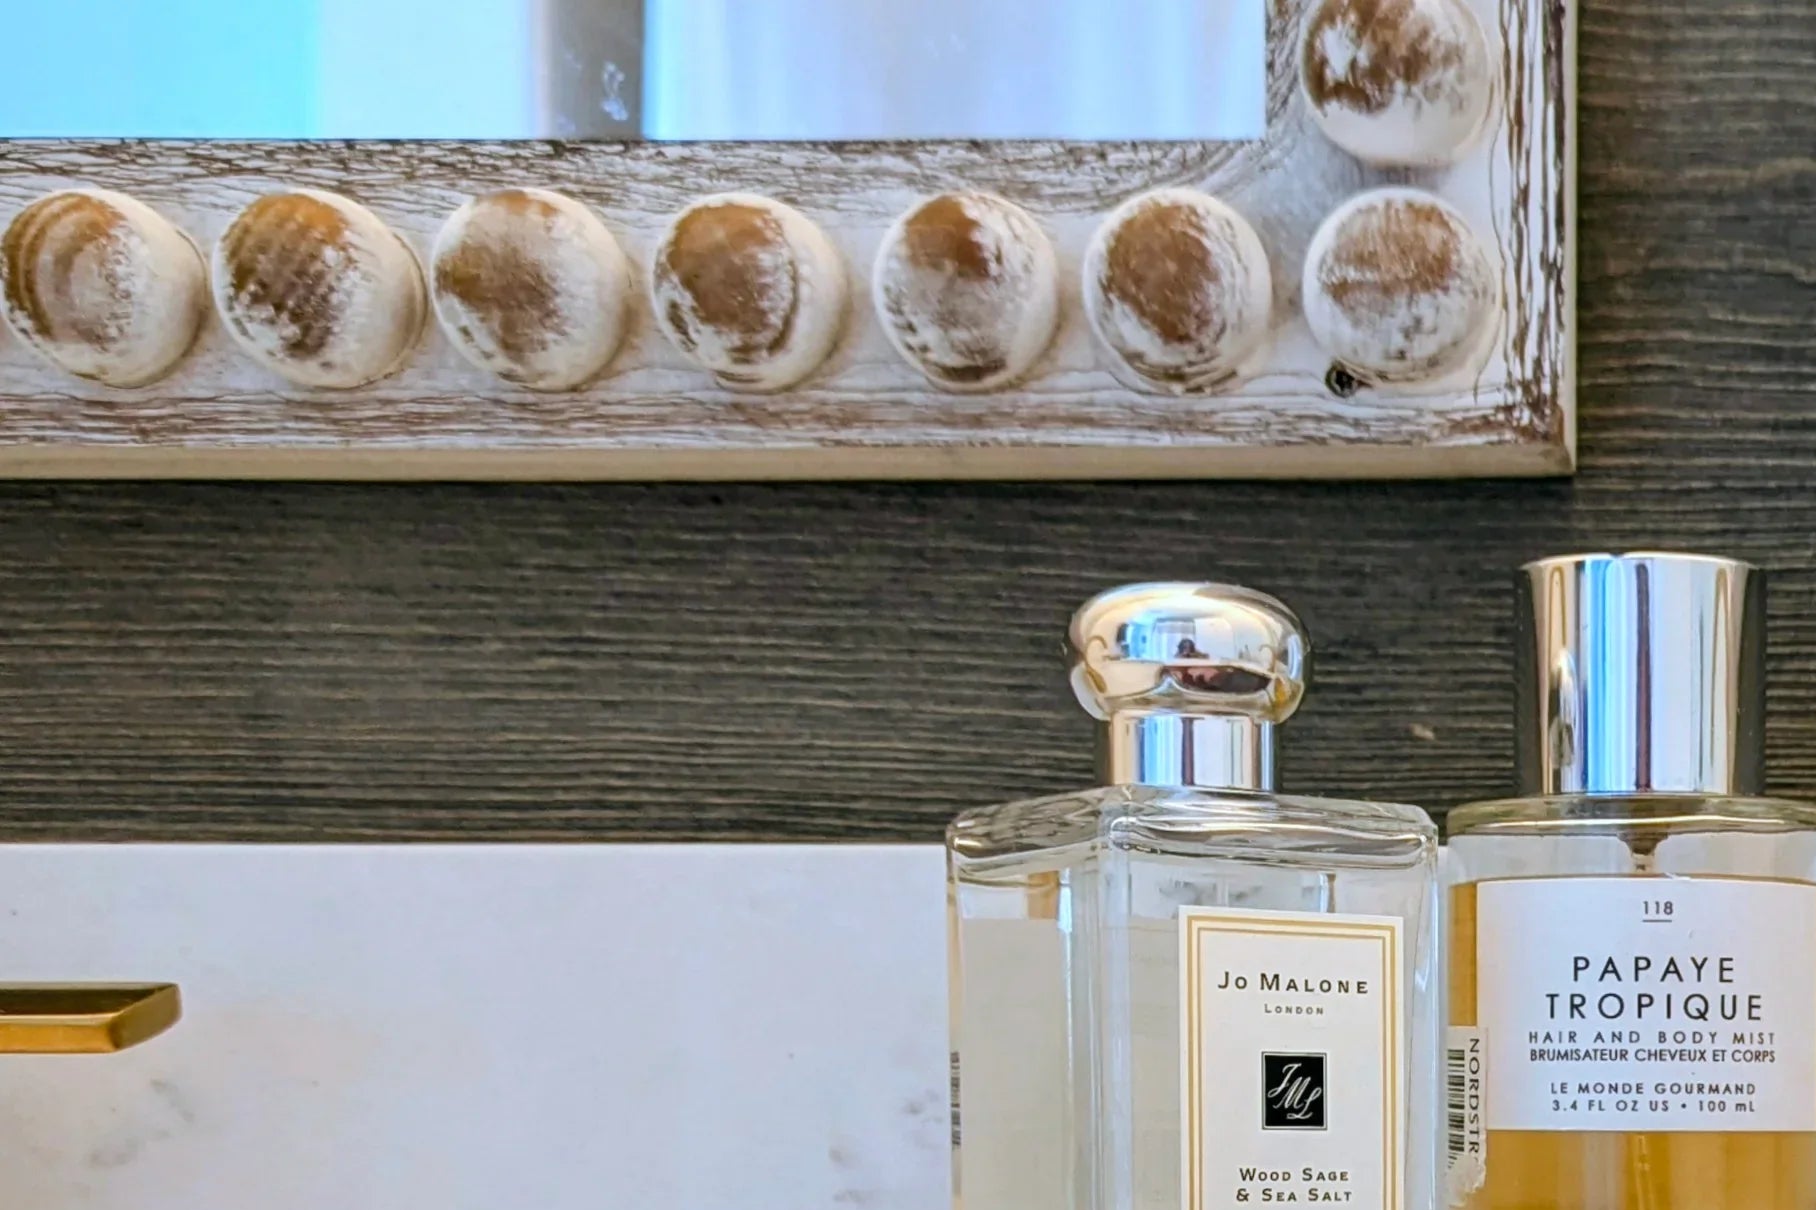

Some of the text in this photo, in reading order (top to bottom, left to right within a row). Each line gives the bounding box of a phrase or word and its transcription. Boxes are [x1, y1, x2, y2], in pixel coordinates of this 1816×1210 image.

[1642, 901, 1674, 916] 118
[1572, 956, 1735, 983] PAPAYE
[1545, 992, 1762, 1022] TROPIQUE
[1528, 1030, 1775, 1046] HAIR AND BODY MIST
[1529, 1047, 1776, 1063] BRUMISATEUR CHEVEUX ET CORPS
[1550, 1082, 1756, 1096] LE MONDE GOURMAND
[1468, 1038, 1480, 1162] NORDSTR
[1552, 1099, 1756, 1113] 3.4 FL OZ US 100 mL
[1235, 1188, 1251, 1203] &
